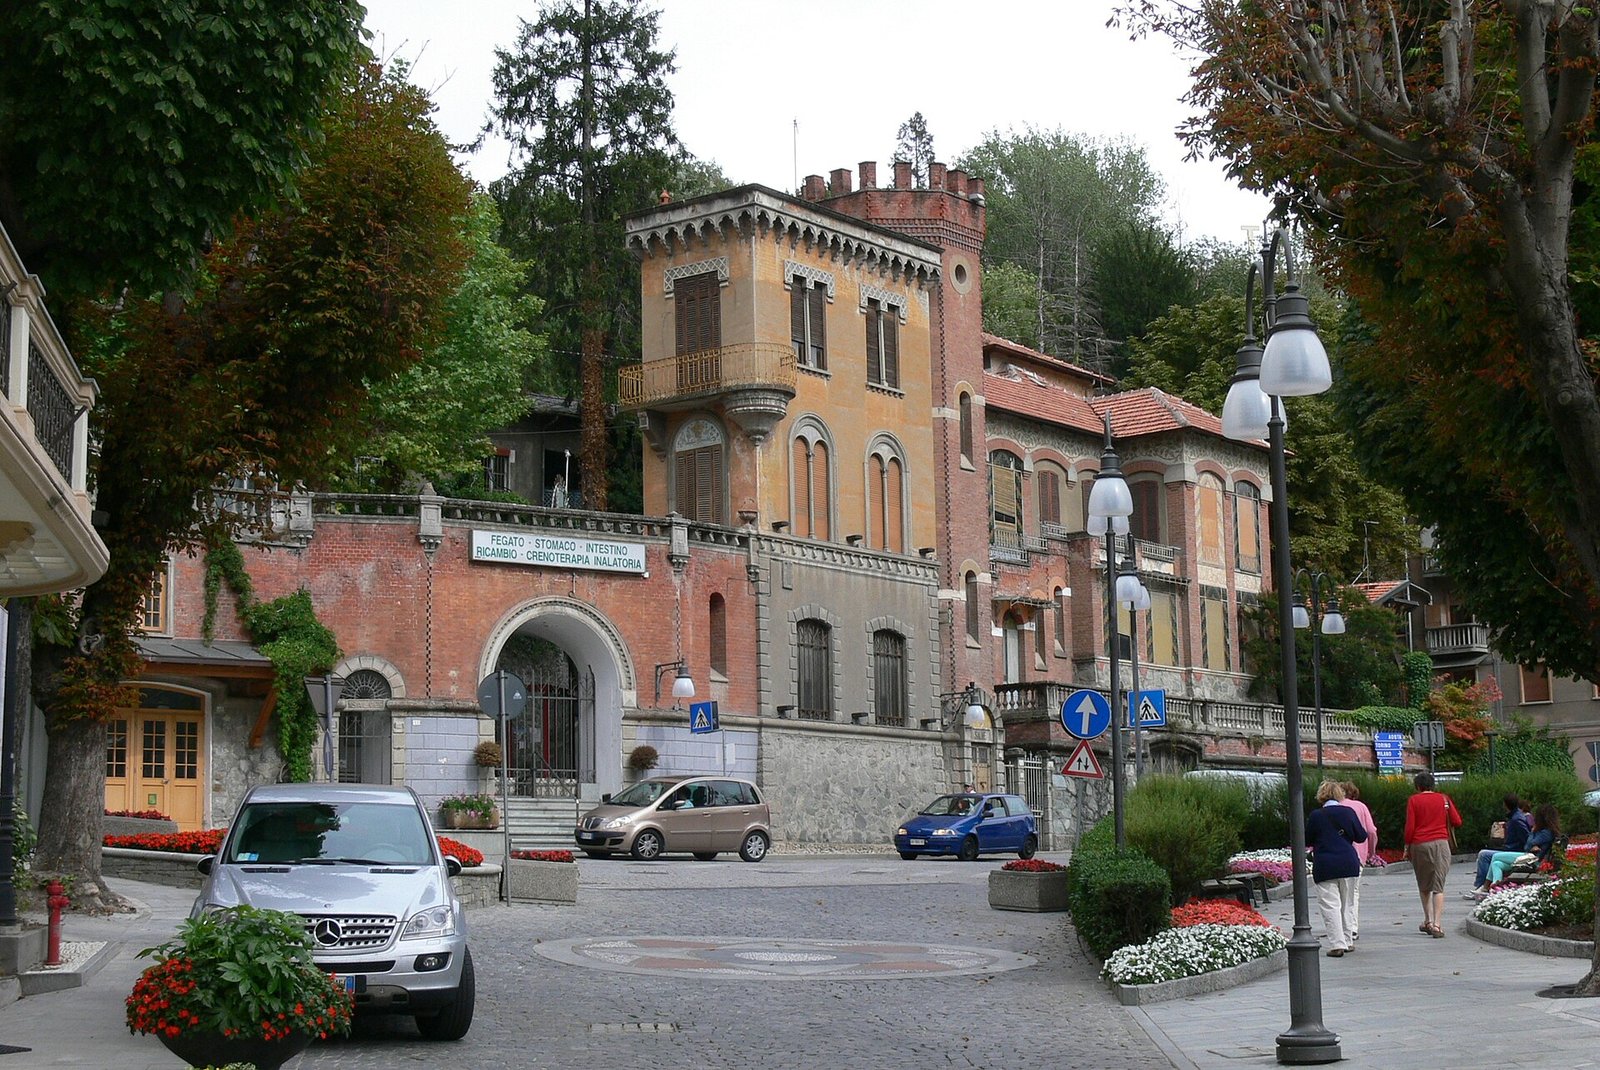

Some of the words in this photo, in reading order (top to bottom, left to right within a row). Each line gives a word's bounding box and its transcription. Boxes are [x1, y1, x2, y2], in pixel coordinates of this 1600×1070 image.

[491, 534, 525, 547] FEGATO
[535, 538, 576, 551] STOMACO
[586, 542, 628, 556] INTESTINO
[476, 546, 517, 559] RICAMBIO
[526, 550, 590, 565] CRENOTERAPIA
[593, 557, 642, 569] INALATORIA
